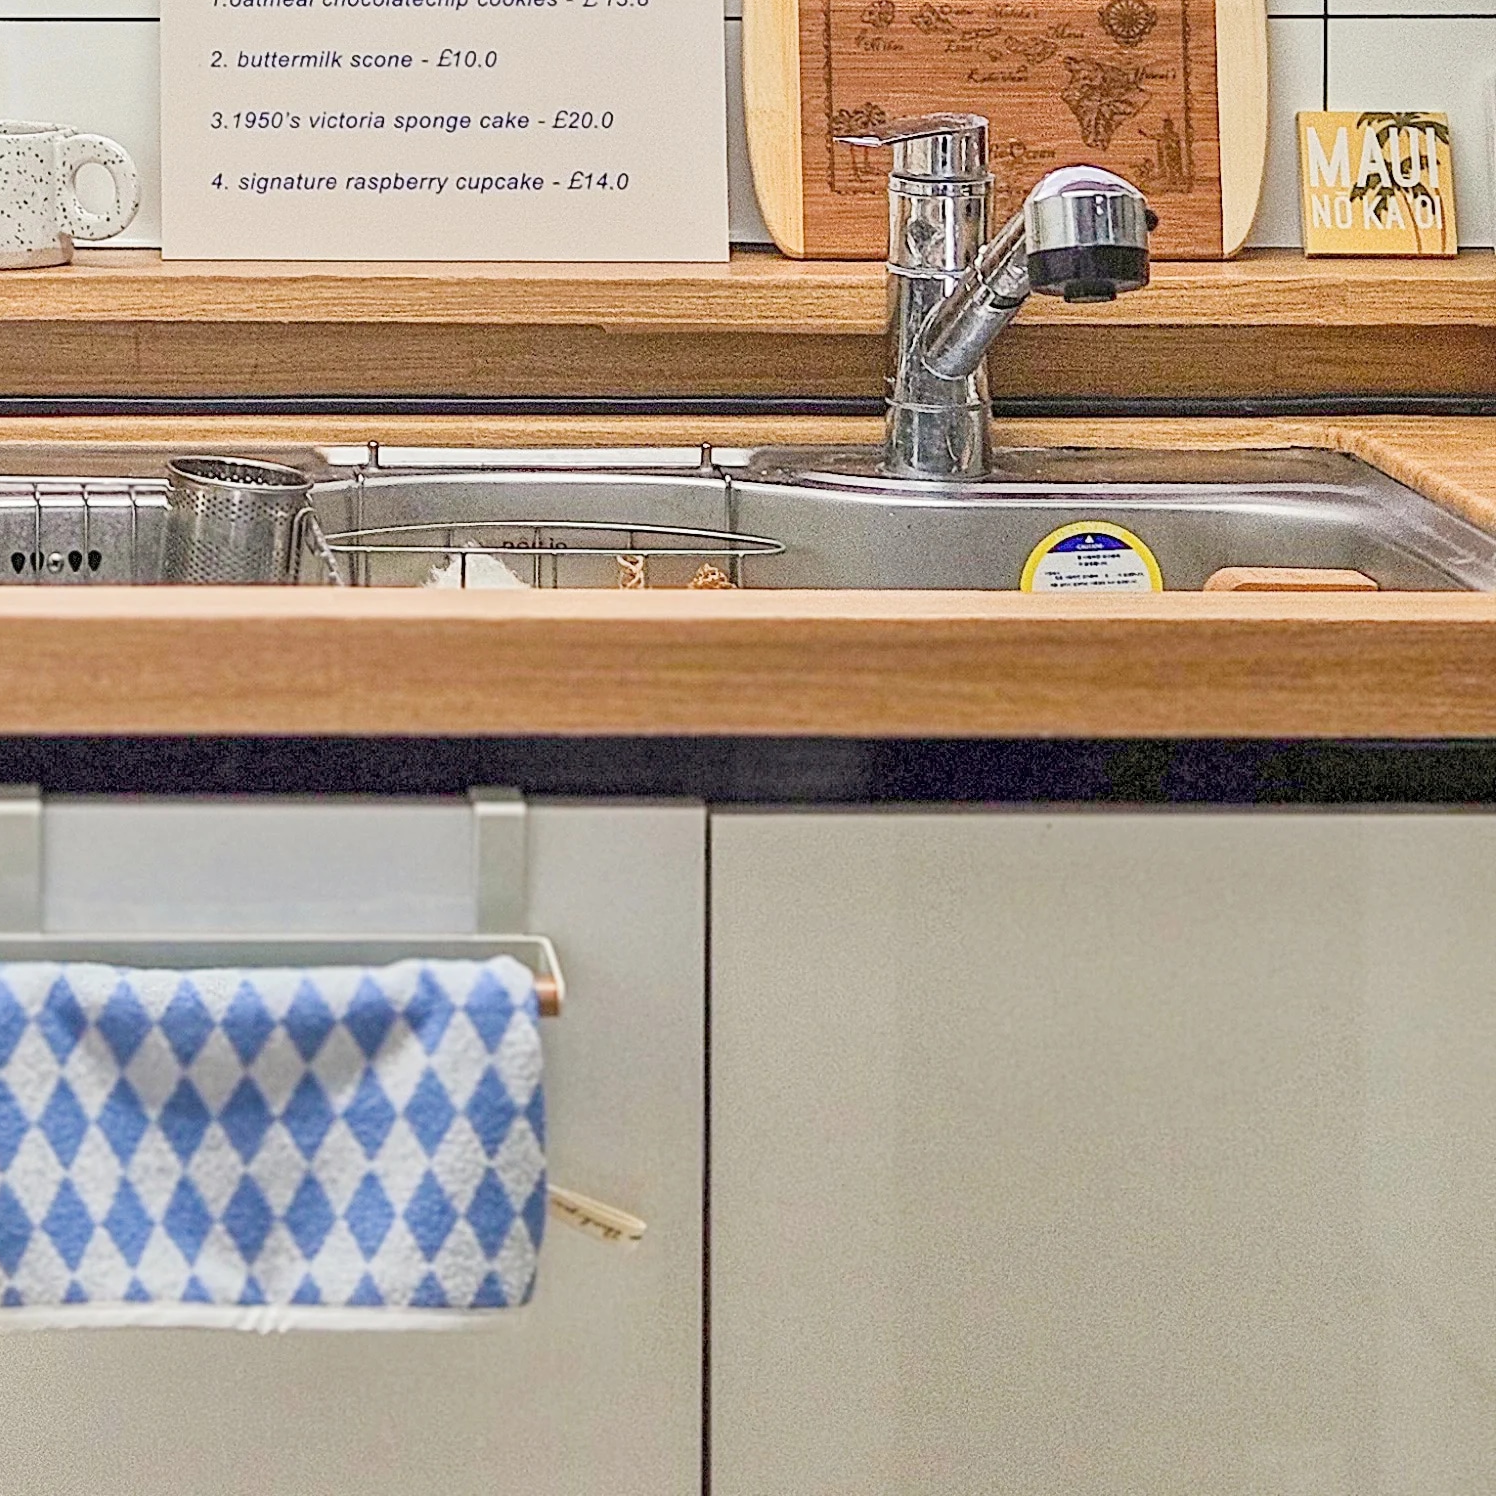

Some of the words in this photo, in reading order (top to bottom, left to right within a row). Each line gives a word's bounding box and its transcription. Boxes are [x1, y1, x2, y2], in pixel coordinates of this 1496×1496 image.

[209, 49, 228, 69] 2.
[236, 50, 343, 69] buttermilk
[349, 54, 414, 69] scone
[435, 47, 498, 69] £10.0
[308, 110, 386, 130] victoria
[393, 114, 472, 134] sponge
[479, 110, 531, 130] cake
[551, 109, 615, 130] £20.0
[1306, 126, 1439, 189] MAUI
[210, 172, 229, 191] 4.
[237, 172, 338, 195] signature
[345, 172, 450, 196] raspberry
[455, 172, 545, 195] cupcake
[566, 170, 630, 191] £14.0
[1363, 194, 1406, 230] KA
